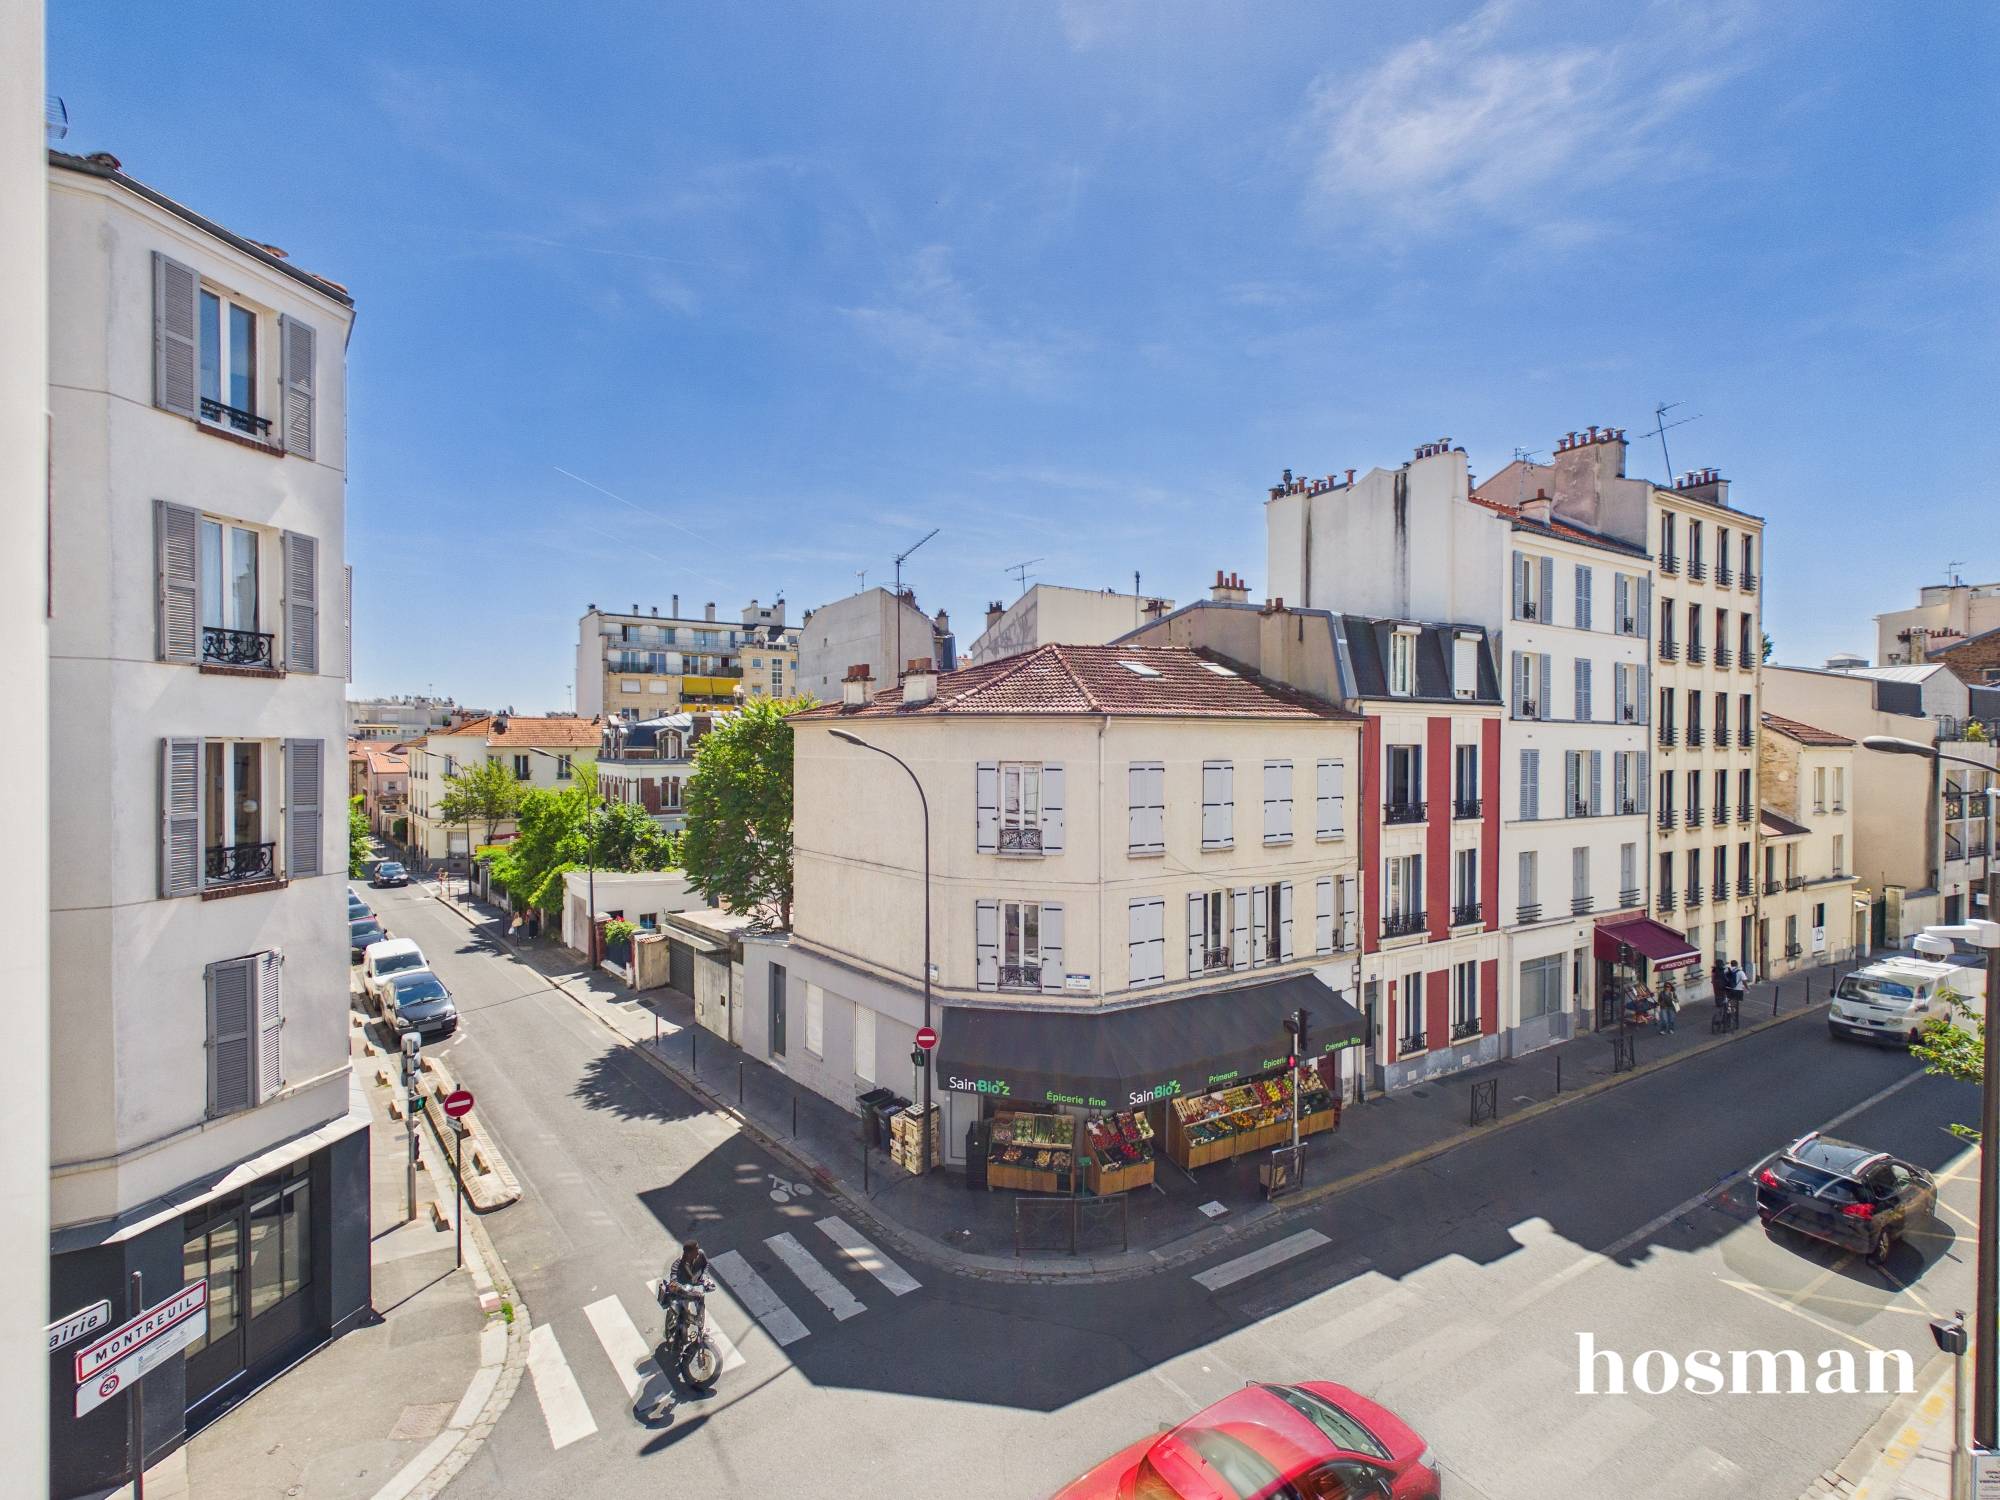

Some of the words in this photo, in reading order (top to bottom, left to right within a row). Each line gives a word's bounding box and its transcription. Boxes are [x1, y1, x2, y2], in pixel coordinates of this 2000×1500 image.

[1209, 1070, 1238, 1084] Primeurs
[1046, 1090, 1084, 1104] Épicerie
[1088, 1096, 1107, 1106] fine
[49, 1315, 97, 1347] airie
[95, 1298, 193, 1364] MONTREUIL
[103, 1380, 116, 1393] 30
